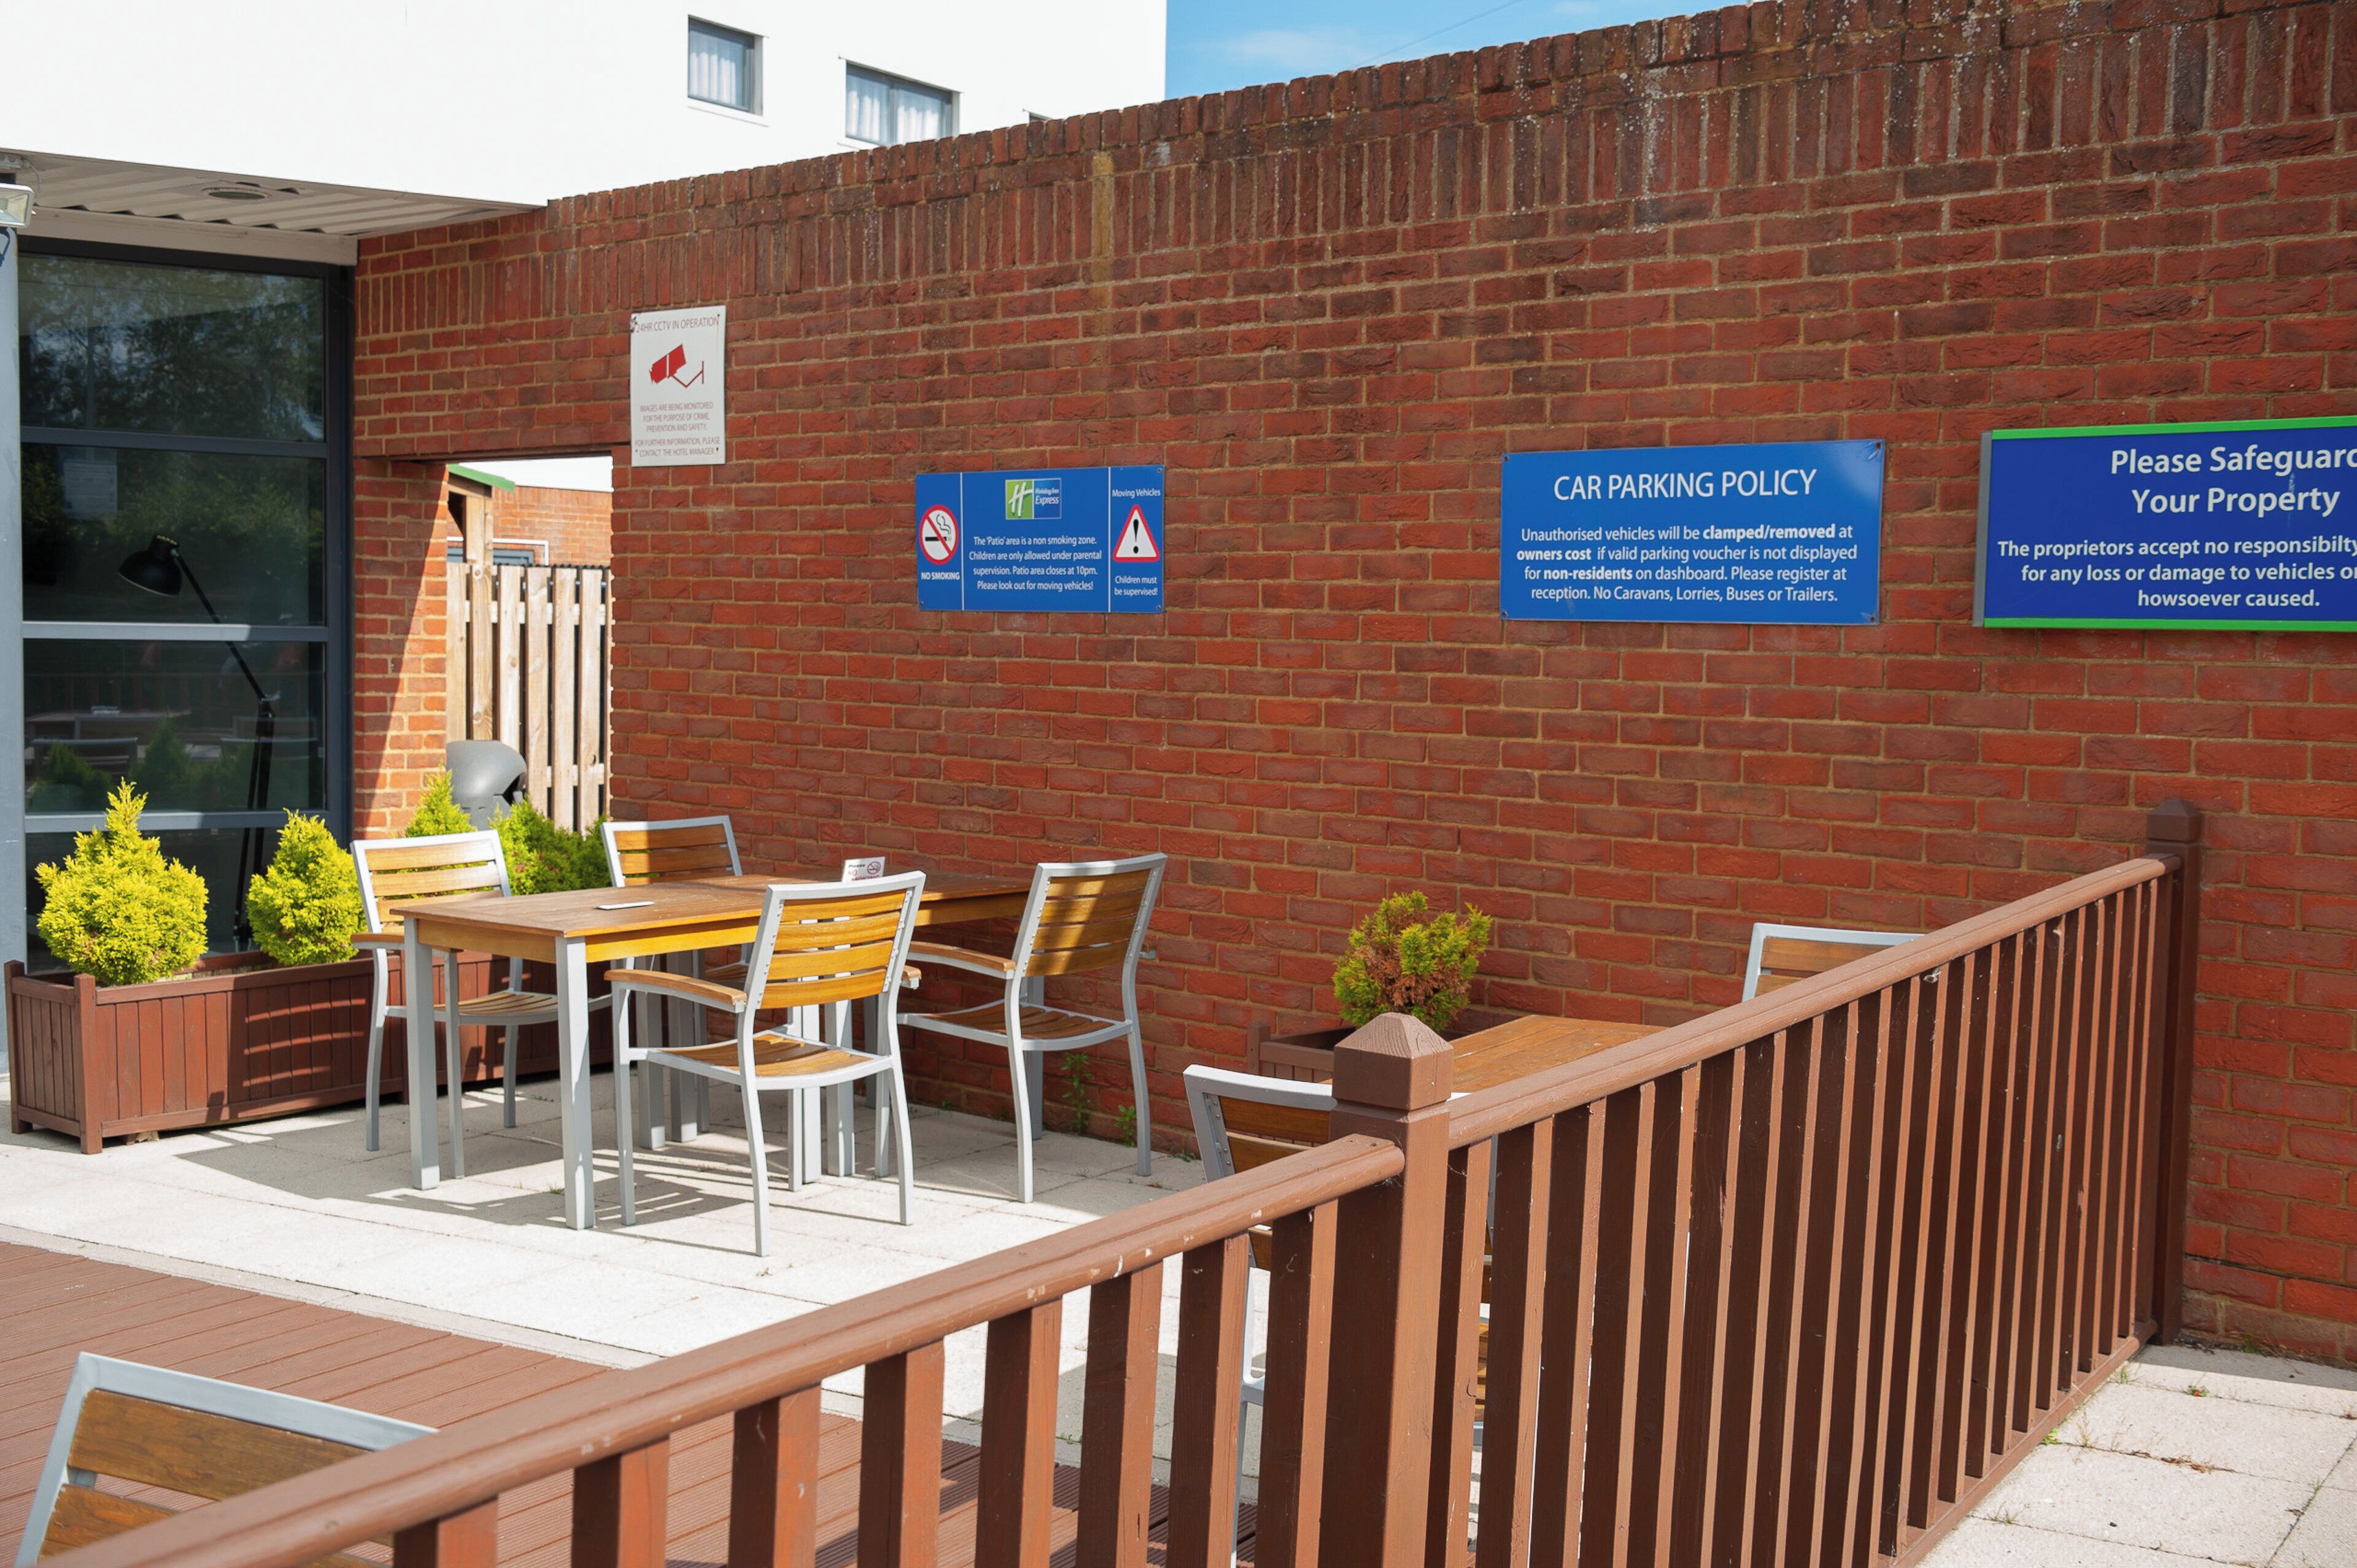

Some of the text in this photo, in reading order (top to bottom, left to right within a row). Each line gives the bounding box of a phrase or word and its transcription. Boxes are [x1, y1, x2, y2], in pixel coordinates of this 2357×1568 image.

[654, 320, 671, 331] CCTV
[673, 320, 679, 330] IN
[681, 317, 718, 329] OPERATION
[2111, 449, 2202, 474] Please
[1554, 468, 1817, 501] CAR PARKING POLICY
[1035, 495, 1059, 506] Express
[1112, 488, 1161, 498] Moving Vehicles
[2132, 487, 2340, 517] Your Property
[1522, 523, 1853, 543] Unauthorised vehicles will be clamped/removed at
[973, 536, 985, 546] The
[1021, 536, 1026, 545] is
[1048, 536, 1077, 546] smoking
[969, 551, 996, 560] Children
[1008, 551, 1023, 562] only
[1024, 551, 1050, 560] allowed
[1051, 551, 1072, 560] under
[1073, 550, 1102, 561] parental
[1516, 544, 1857, 563] owners cost if valid parking voucher is not displayed
[1998, 540, 2030, 556] The
[2034, 540, 2134, 560] proprietors
[2138, 540, 2200, 558] accept
[2204, 542, 2229, 554] no
[931, 571, 960, 581] SMOKING
[973, 566, 1012, 576] supervision.
[1013, 566, 1029, 575] Patio
[1045, 566, 1066, 575] closes
[1077, 566, 1097, 576] 10pm.
[1525, 566, 1847, 584] for non-residents on dashboard. Please register at
[2021, 565, 2046, 581] for
[2050, 568, 2083, 585] any
[2087, 564, 2121, 581] loss
[2125, 568, 2145, 581] or
[2149, 563, 2225, 584] damage
[2230, 565, 2250, 581] to
[2255, 562, 2335, 580] vehicles
[977, 581, 997, 590] Please
[998, 581, 1013, 590] look
[1026, 581, 1036, 590] for
[1037, 581, 1063, 592] moving
[1064, 581, 1094, 590] vehicles!
[1115, 576, 1140, 584] Children
[1123, 587, 1158, 597] supervised!
[1531, 586, 1838, 602] reception. No Caravans, Lorries, Buses or Trailers.
[2138, 589, 2320, 606] howsoever caused.
